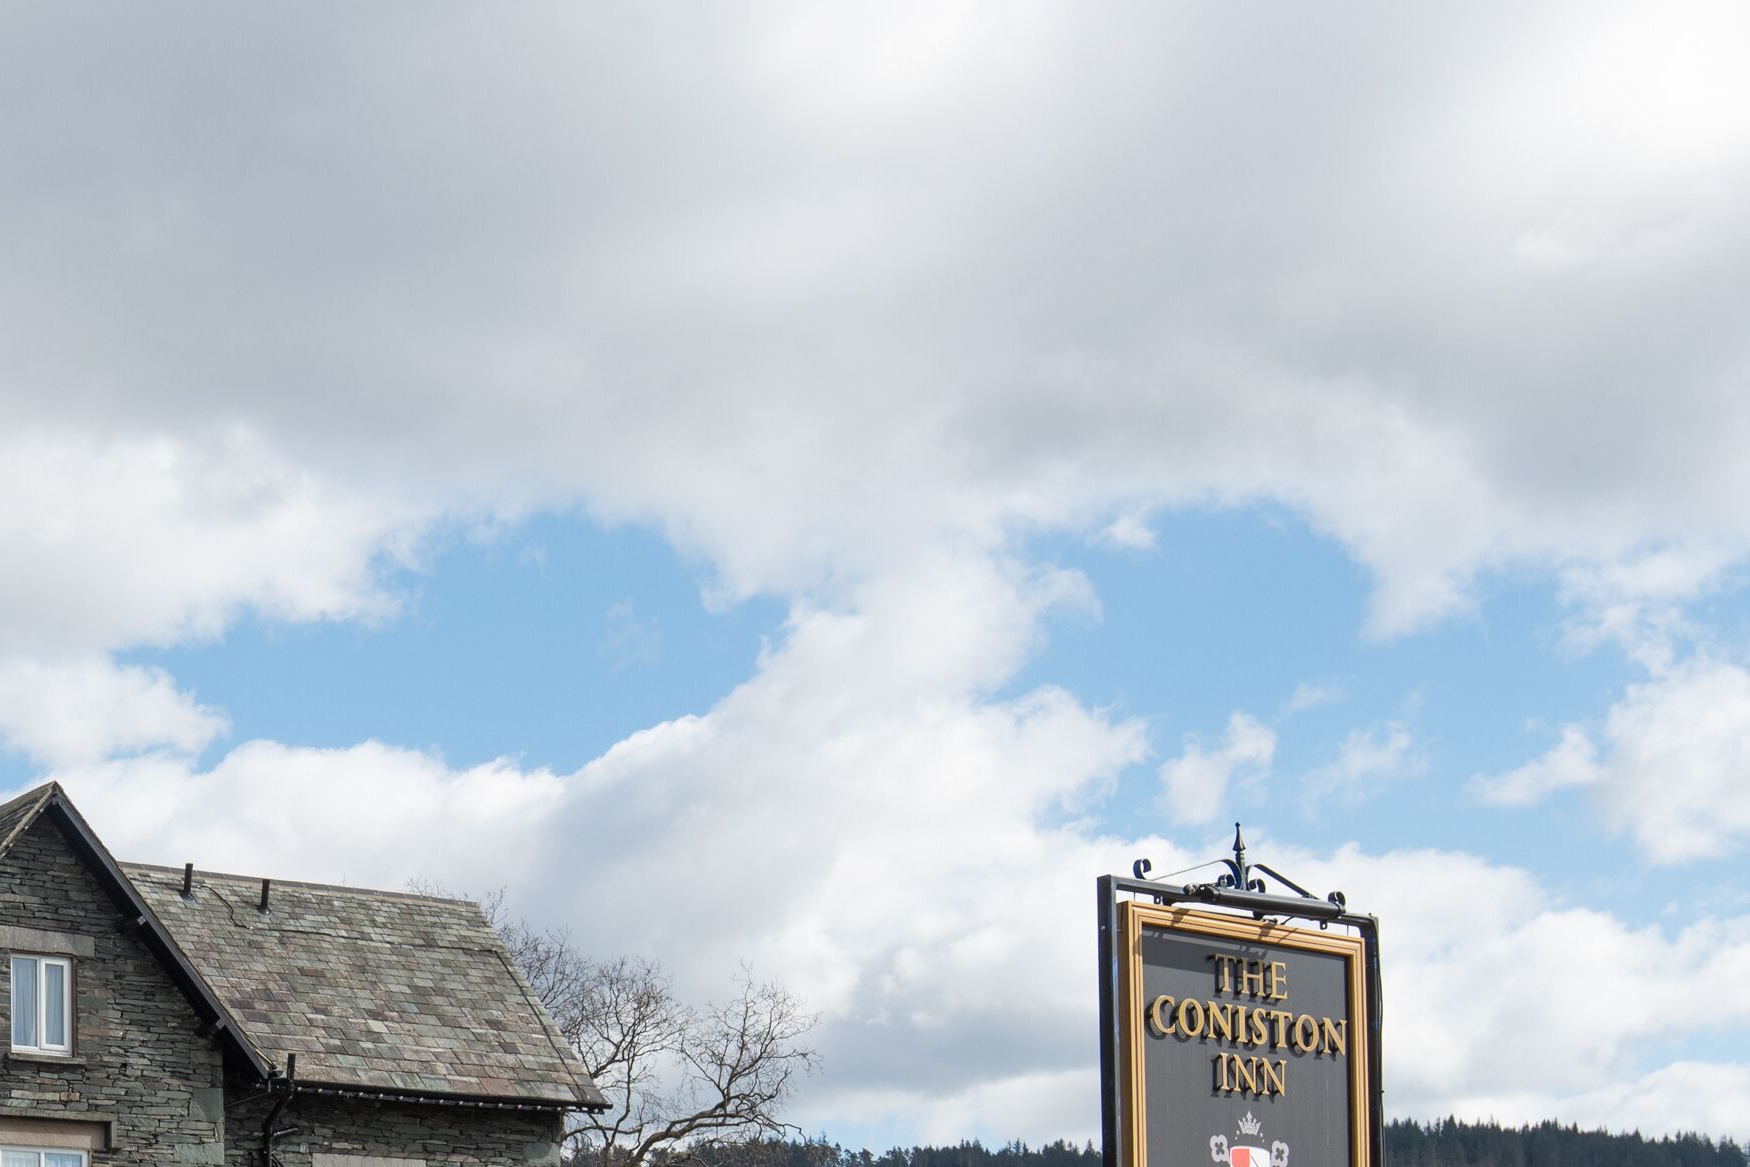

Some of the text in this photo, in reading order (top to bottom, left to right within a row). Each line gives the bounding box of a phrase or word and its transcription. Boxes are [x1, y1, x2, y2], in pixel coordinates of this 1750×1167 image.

[1214, 953, 1288, 1000] THE
[1152, 994, 1347, 1056] CONISTON
[1218, 1052, 1287, 1097] INN
